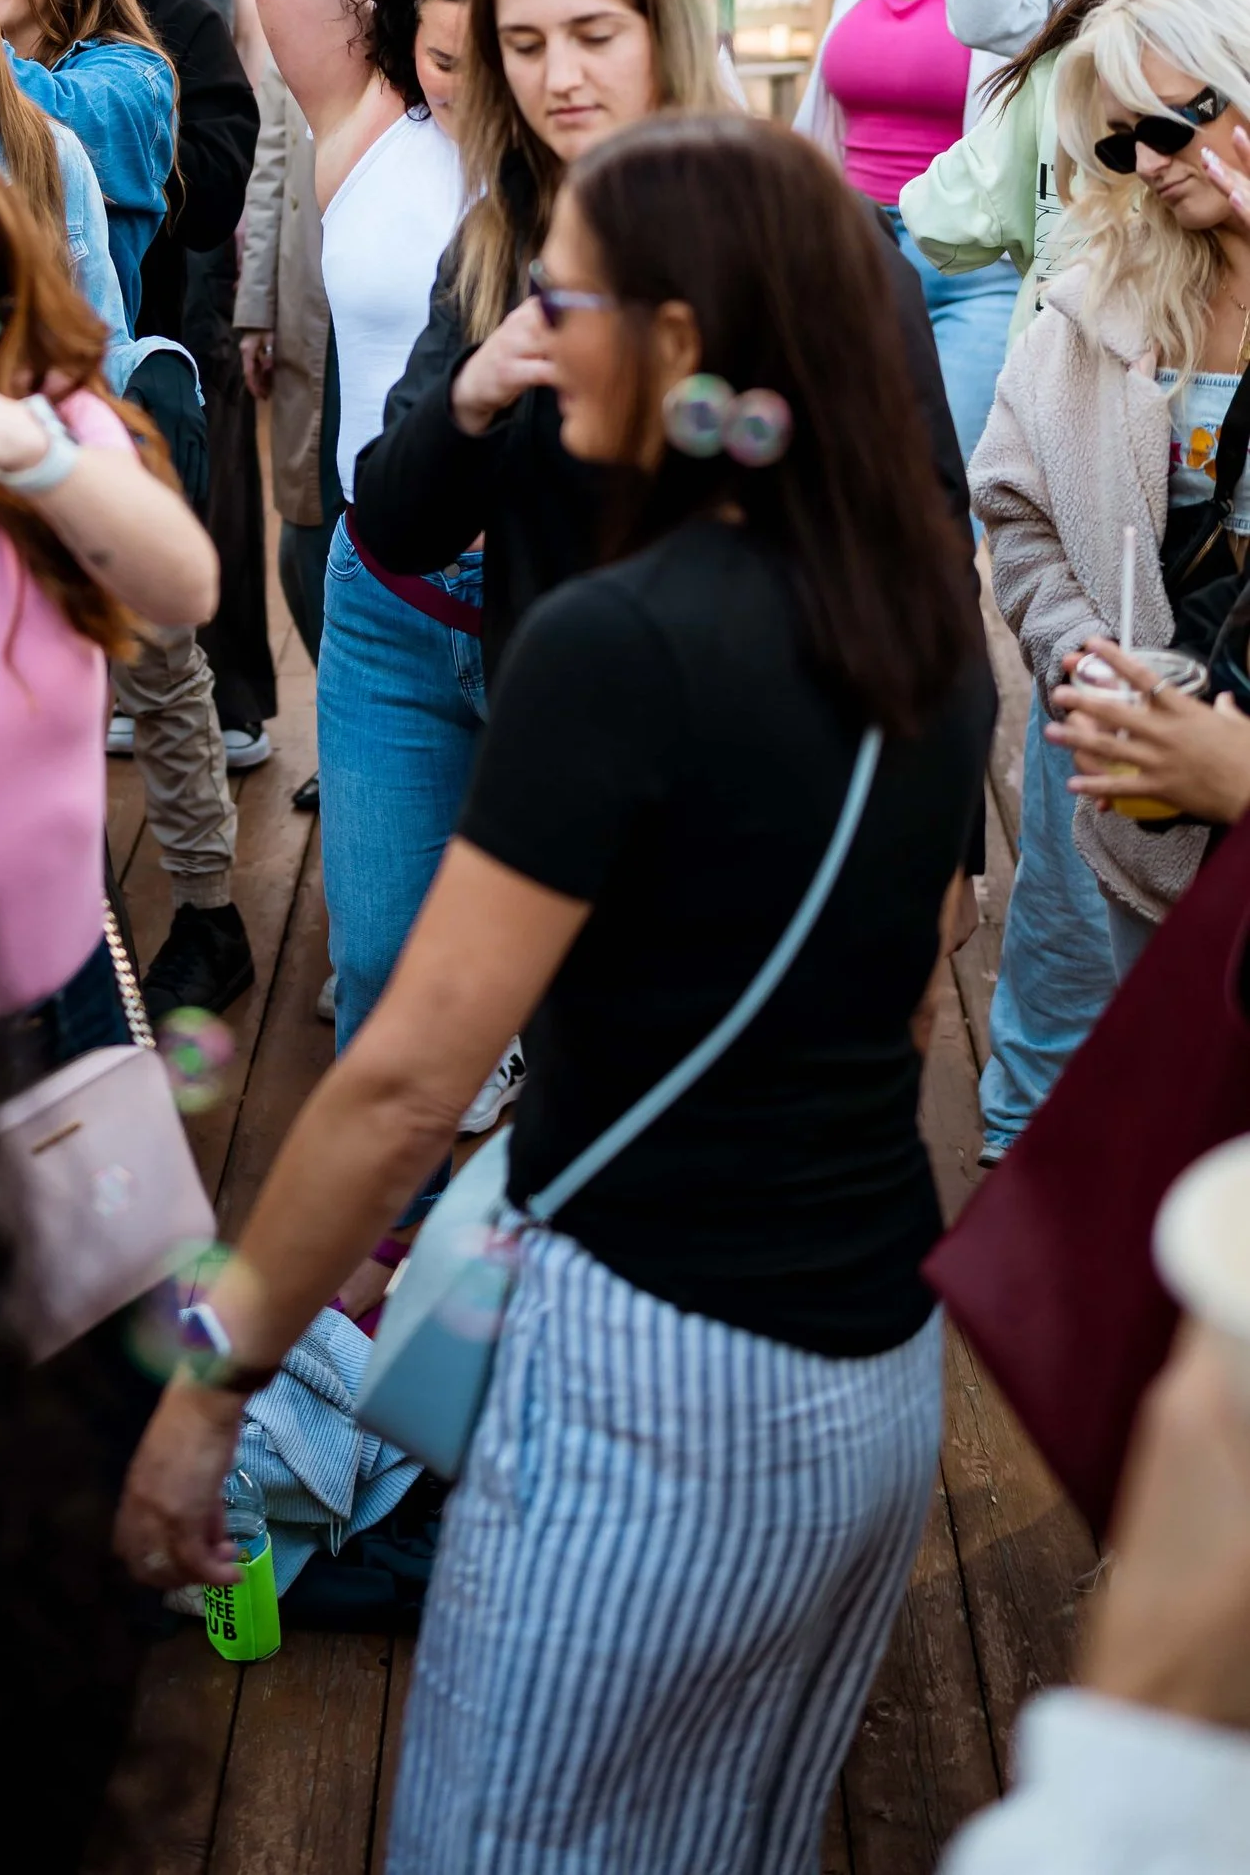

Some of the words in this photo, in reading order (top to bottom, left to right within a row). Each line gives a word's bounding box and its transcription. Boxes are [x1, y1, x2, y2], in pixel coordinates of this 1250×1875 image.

[204, 1581, 235, 1601] USE
[204, 1591, 236, 1622] FFEE
[208, 1612, 238, 1641] UB
